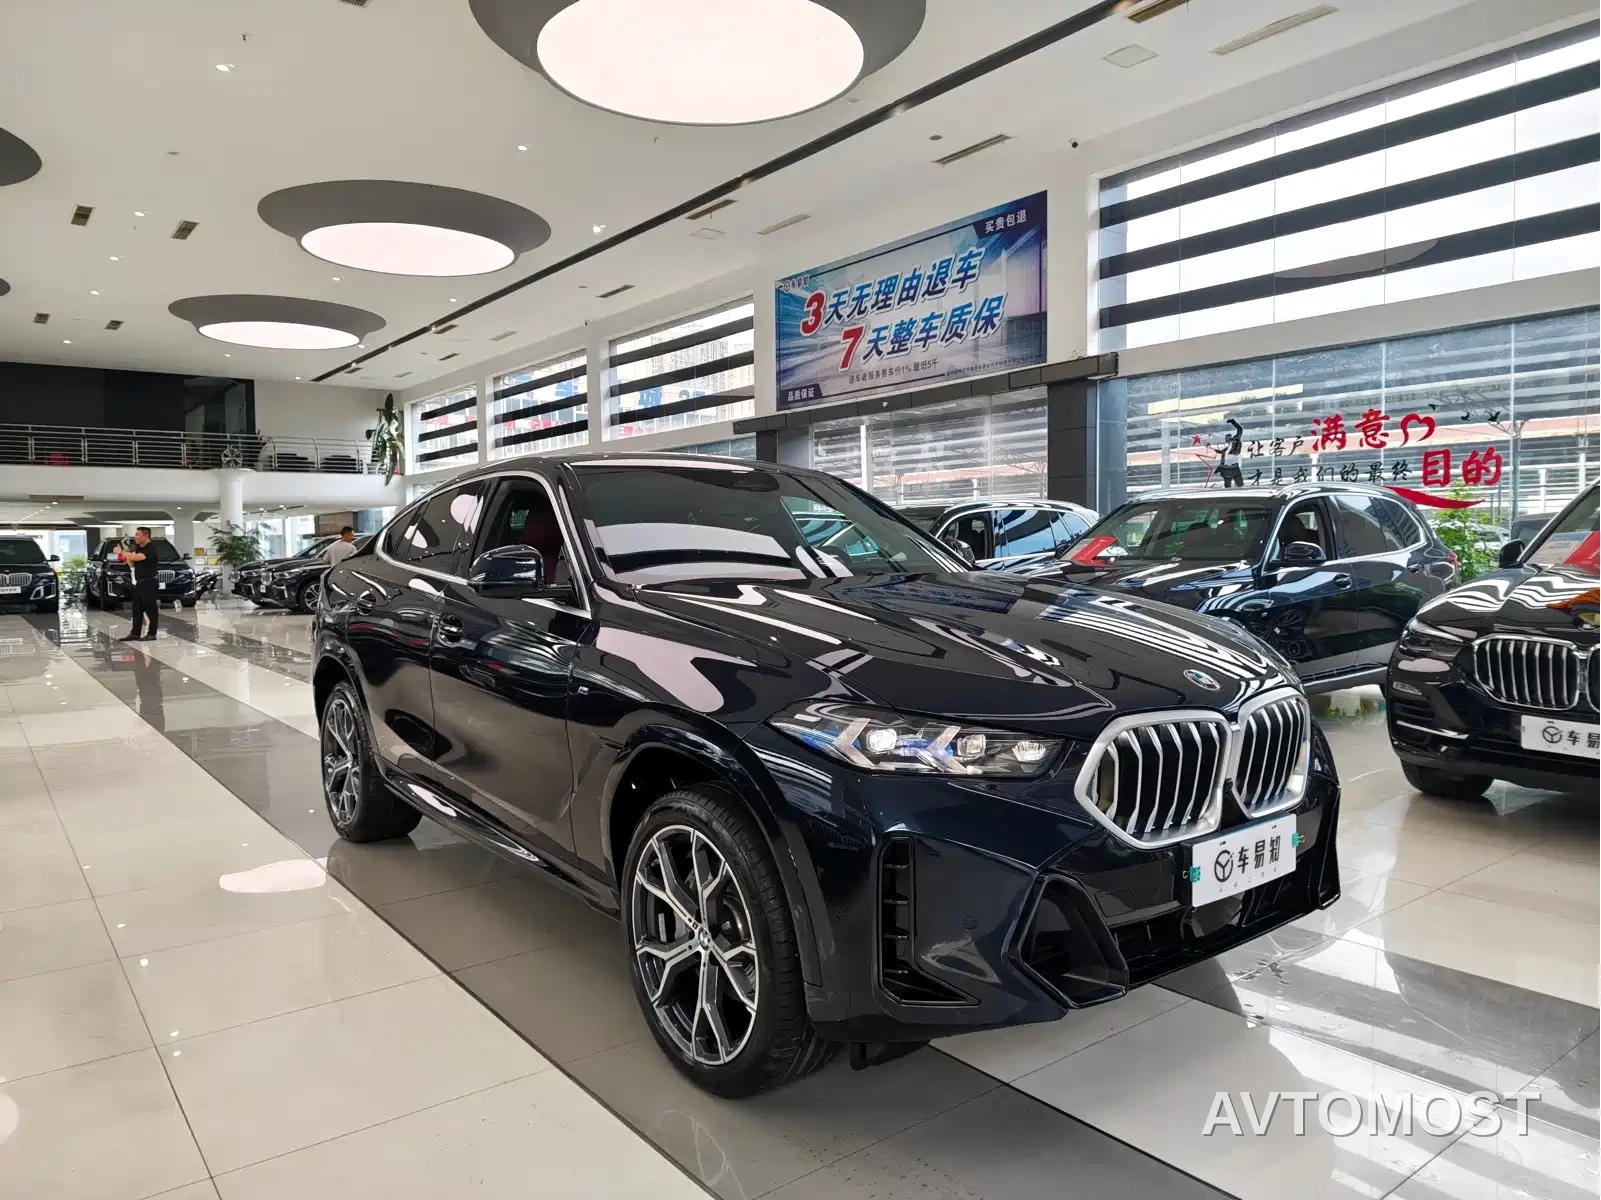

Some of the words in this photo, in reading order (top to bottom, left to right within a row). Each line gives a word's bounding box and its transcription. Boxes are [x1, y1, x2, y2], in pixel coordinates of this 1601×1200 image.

[985, 209, 1027, 234] 买贵包退
[801, 247, 985, 336] 3天无理由退车
[839, 293, 1007, 371] 7天整车质保
[787, 387, 815, 402] 品质保证
[1247, 435, 1304, 459] 让客户
[1311, 408, 1390, 451] 满意
[1422, 446, 1504, 487] 目的
[1237, 835, 1281, 874] 车易知
